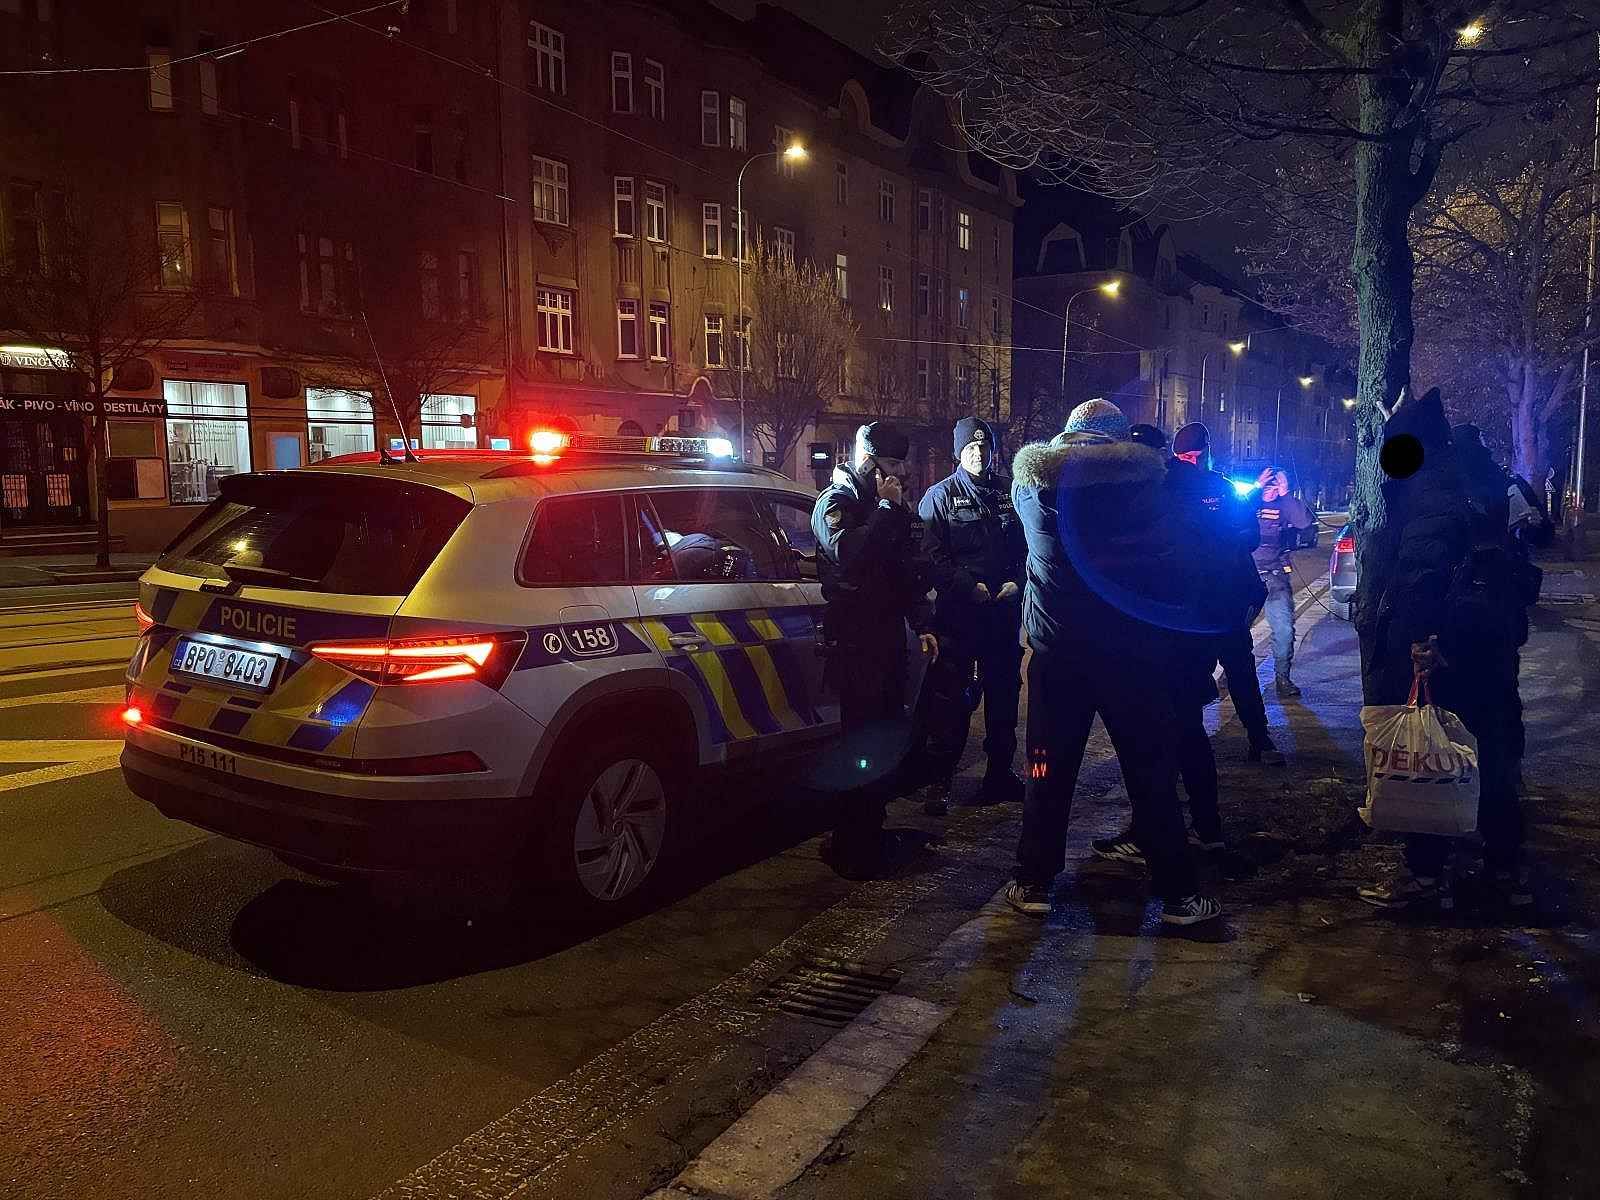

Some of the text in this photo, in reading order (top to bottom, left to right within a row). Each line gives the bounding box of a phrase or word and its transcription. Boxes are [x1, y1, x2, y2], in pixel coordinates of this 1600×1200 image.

[24, 400, 55, 411] PIVO
[64, 400, 95, 412] VÍNO
[103, 402, 165, 414] DESTILÁTY
[220, 605, 297, 639] POLICIE
[571, 627, 611, 649] 158
[223, 652, 268, 685] 8403
[211, 751, 236, 773] 111
